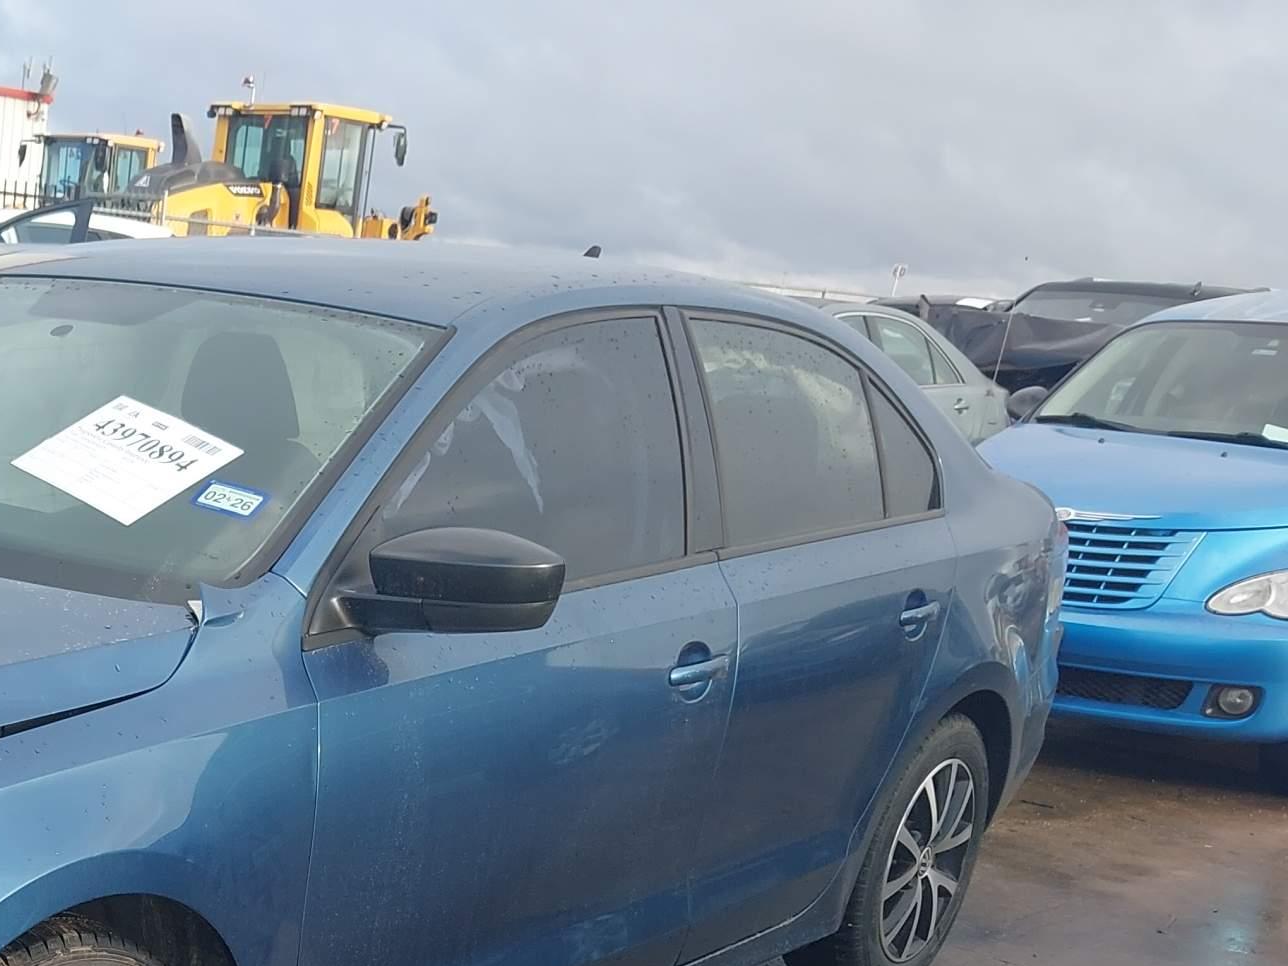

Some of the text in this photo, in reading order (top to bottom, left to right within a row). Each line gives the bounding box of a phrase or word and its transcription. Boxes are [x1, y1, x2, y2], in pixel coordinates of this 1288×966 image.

[94, 419, 198, 473] 43970894
[204, 490, 226, 503] 02
[230, 497, 254, 511] 26
